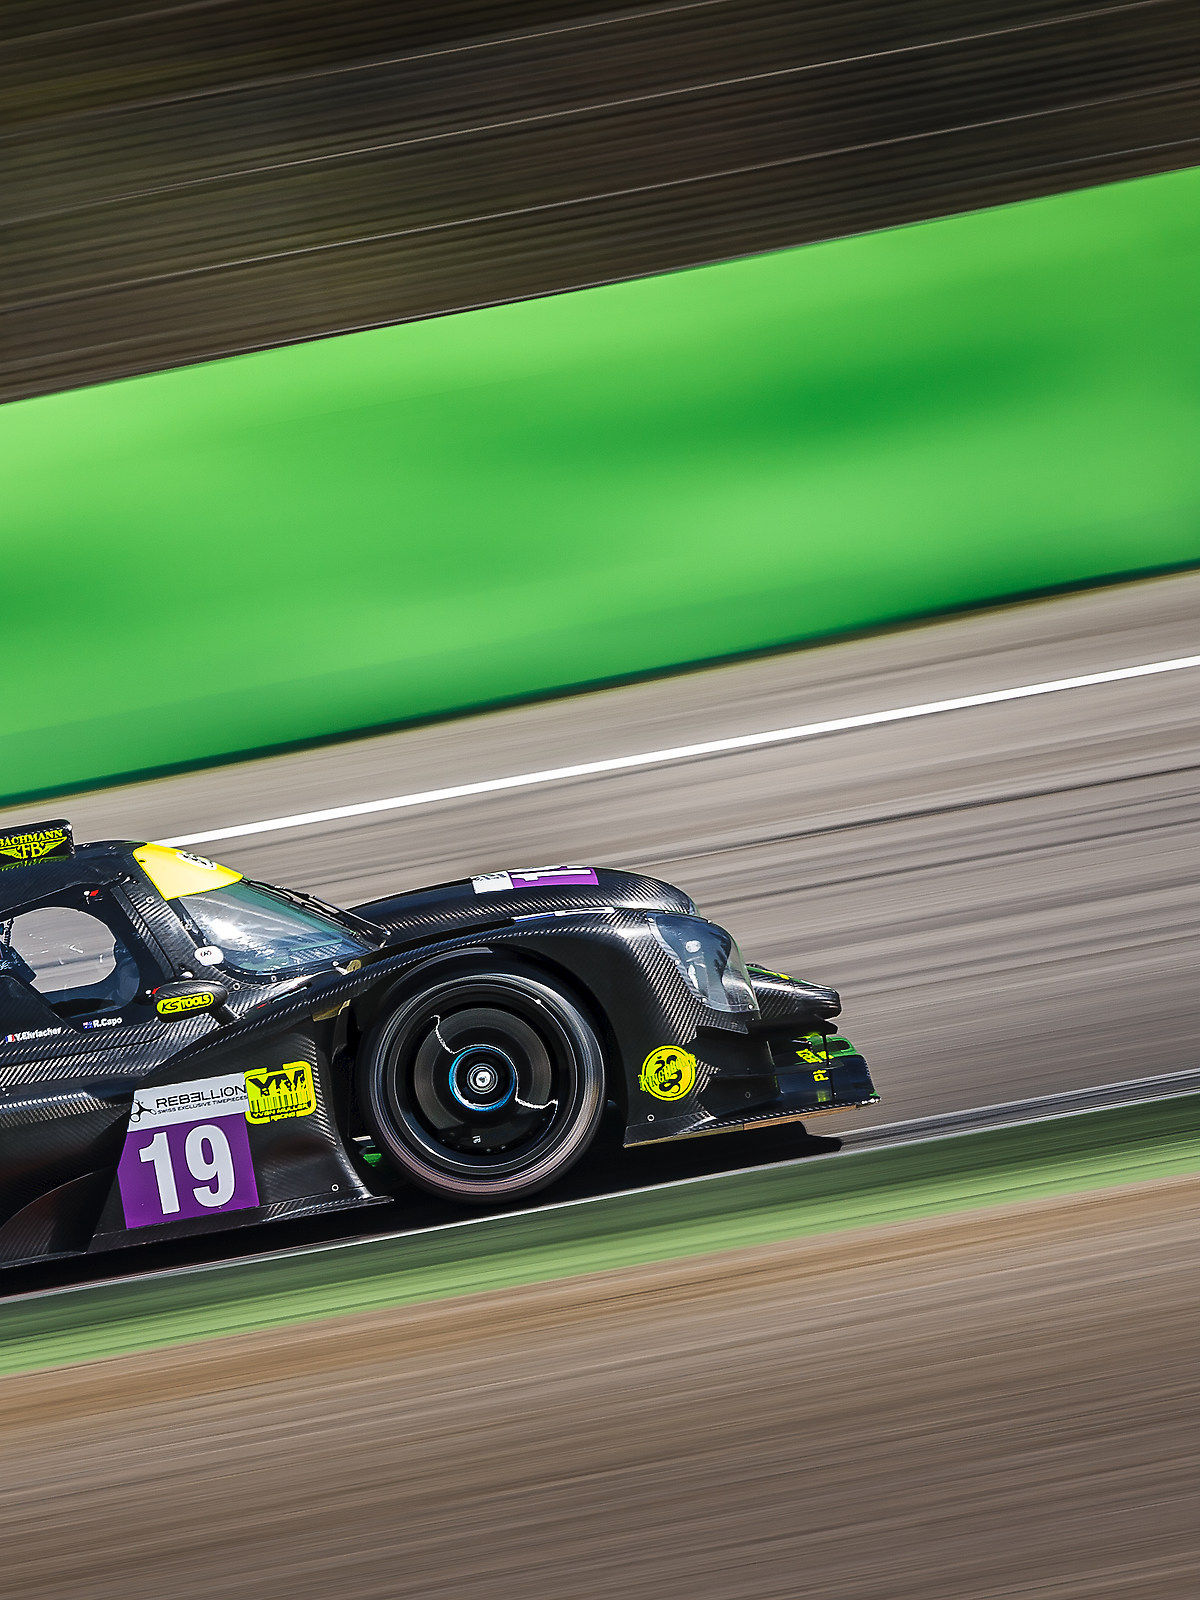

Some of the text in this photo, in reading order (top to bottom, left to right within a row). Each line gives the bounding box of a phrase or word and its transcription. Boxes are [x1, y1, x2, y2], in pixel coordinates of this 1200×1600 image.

[180, 993, 211, 1010] TOOLS
[157, 1107, 178, 1115] SWISS
[177, 1101, 212, 1111] EXCLUSIVE
[139, 1124, 236, 1215] 19
